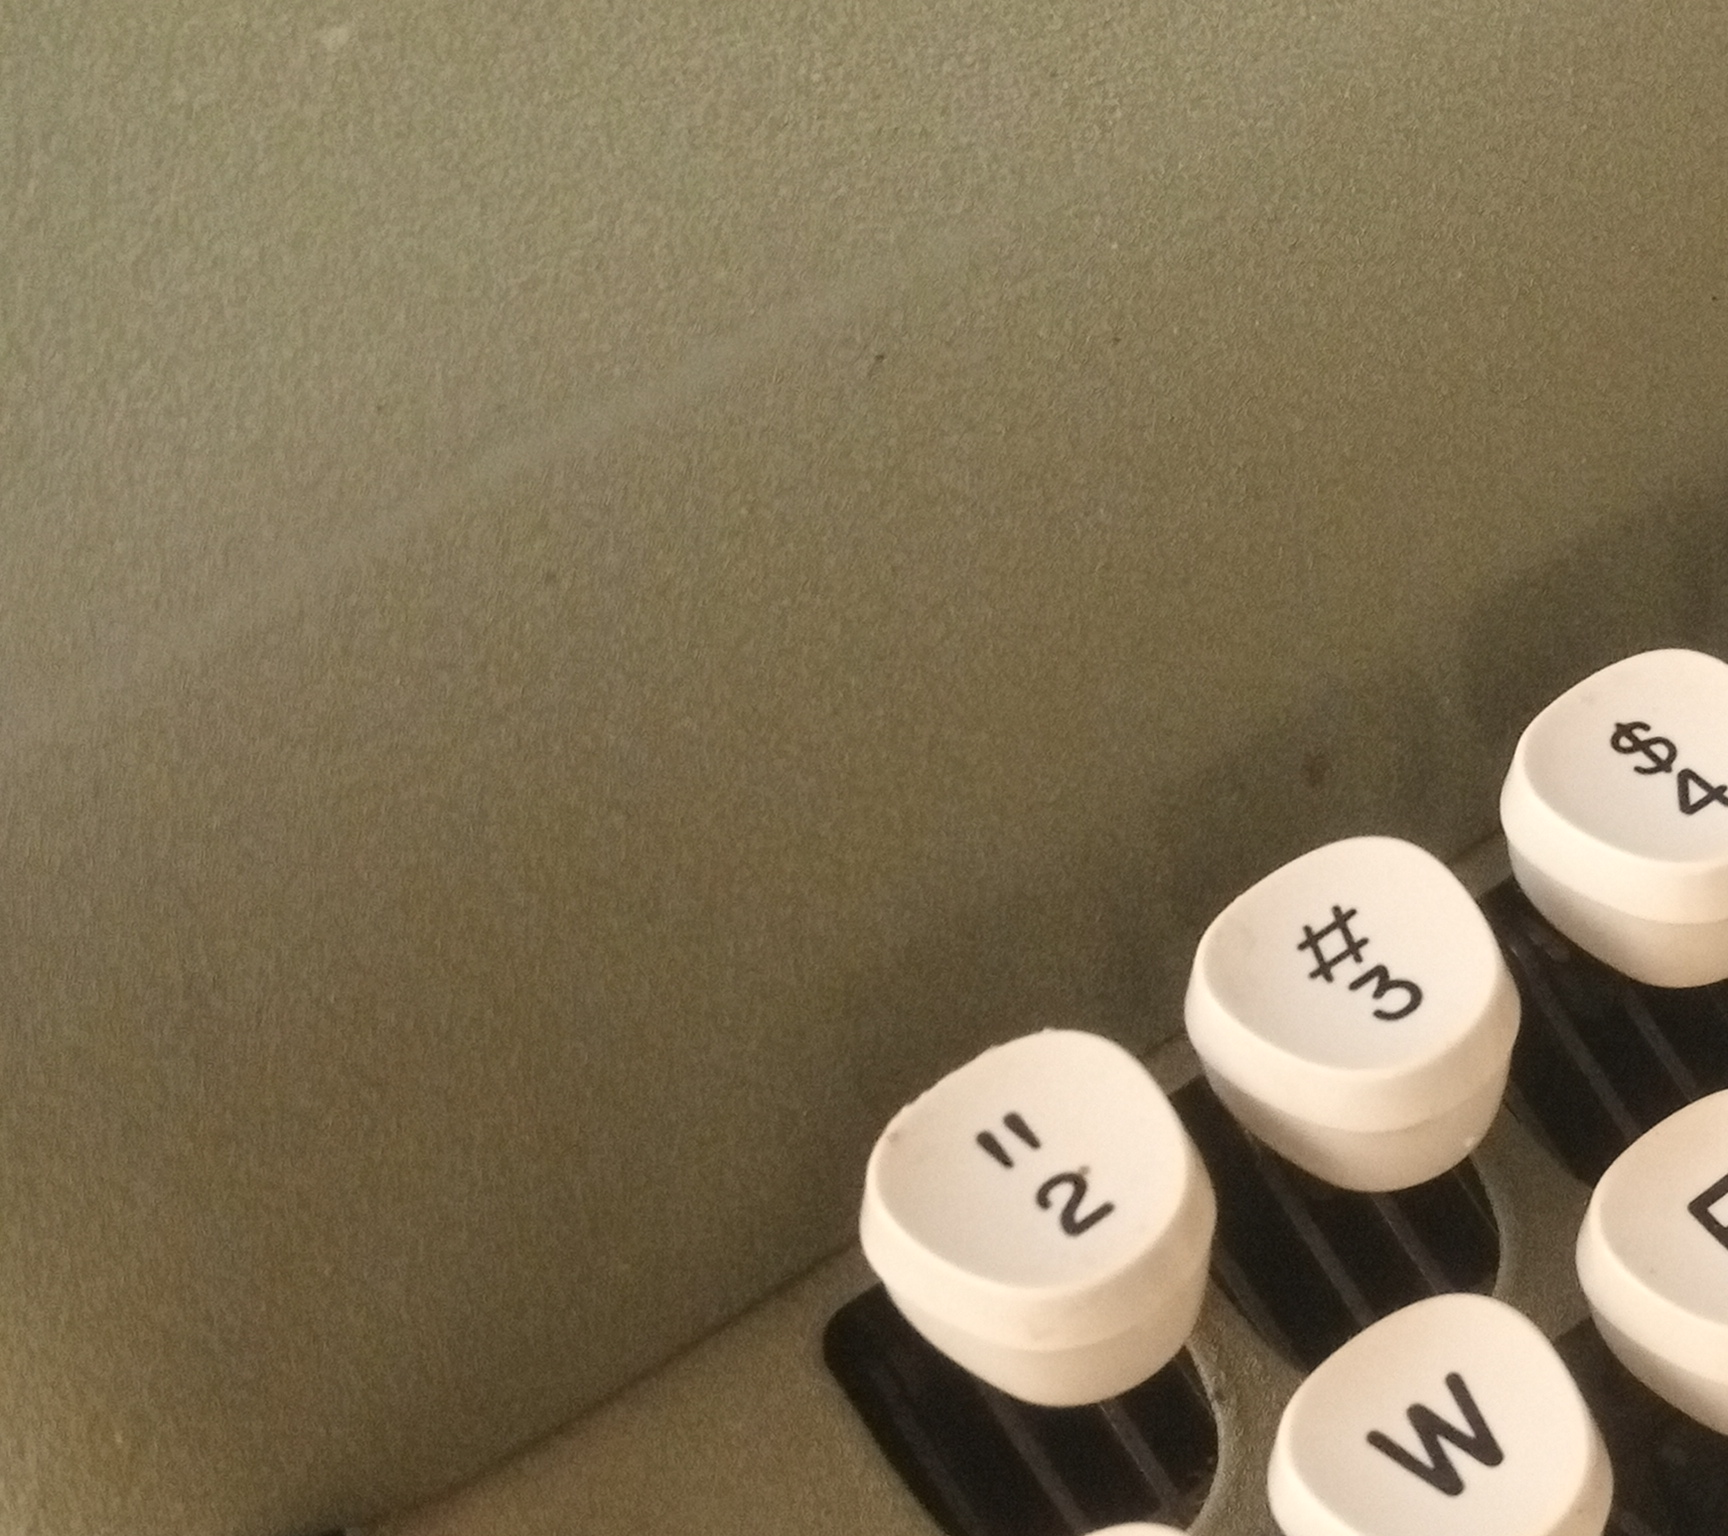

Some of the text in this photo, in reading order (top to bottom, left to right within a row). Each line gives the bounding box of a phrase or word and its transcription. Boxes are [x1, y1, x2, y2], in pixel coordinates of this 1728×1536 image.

[1609, 720, 1678, 776] $
[1296, 904, 1370, 982] #
[1347, 963, 1424, 1022] 3
[1034, 1167, 1115, 1238] 2
[1365, 1371, 1505, 1498] W
